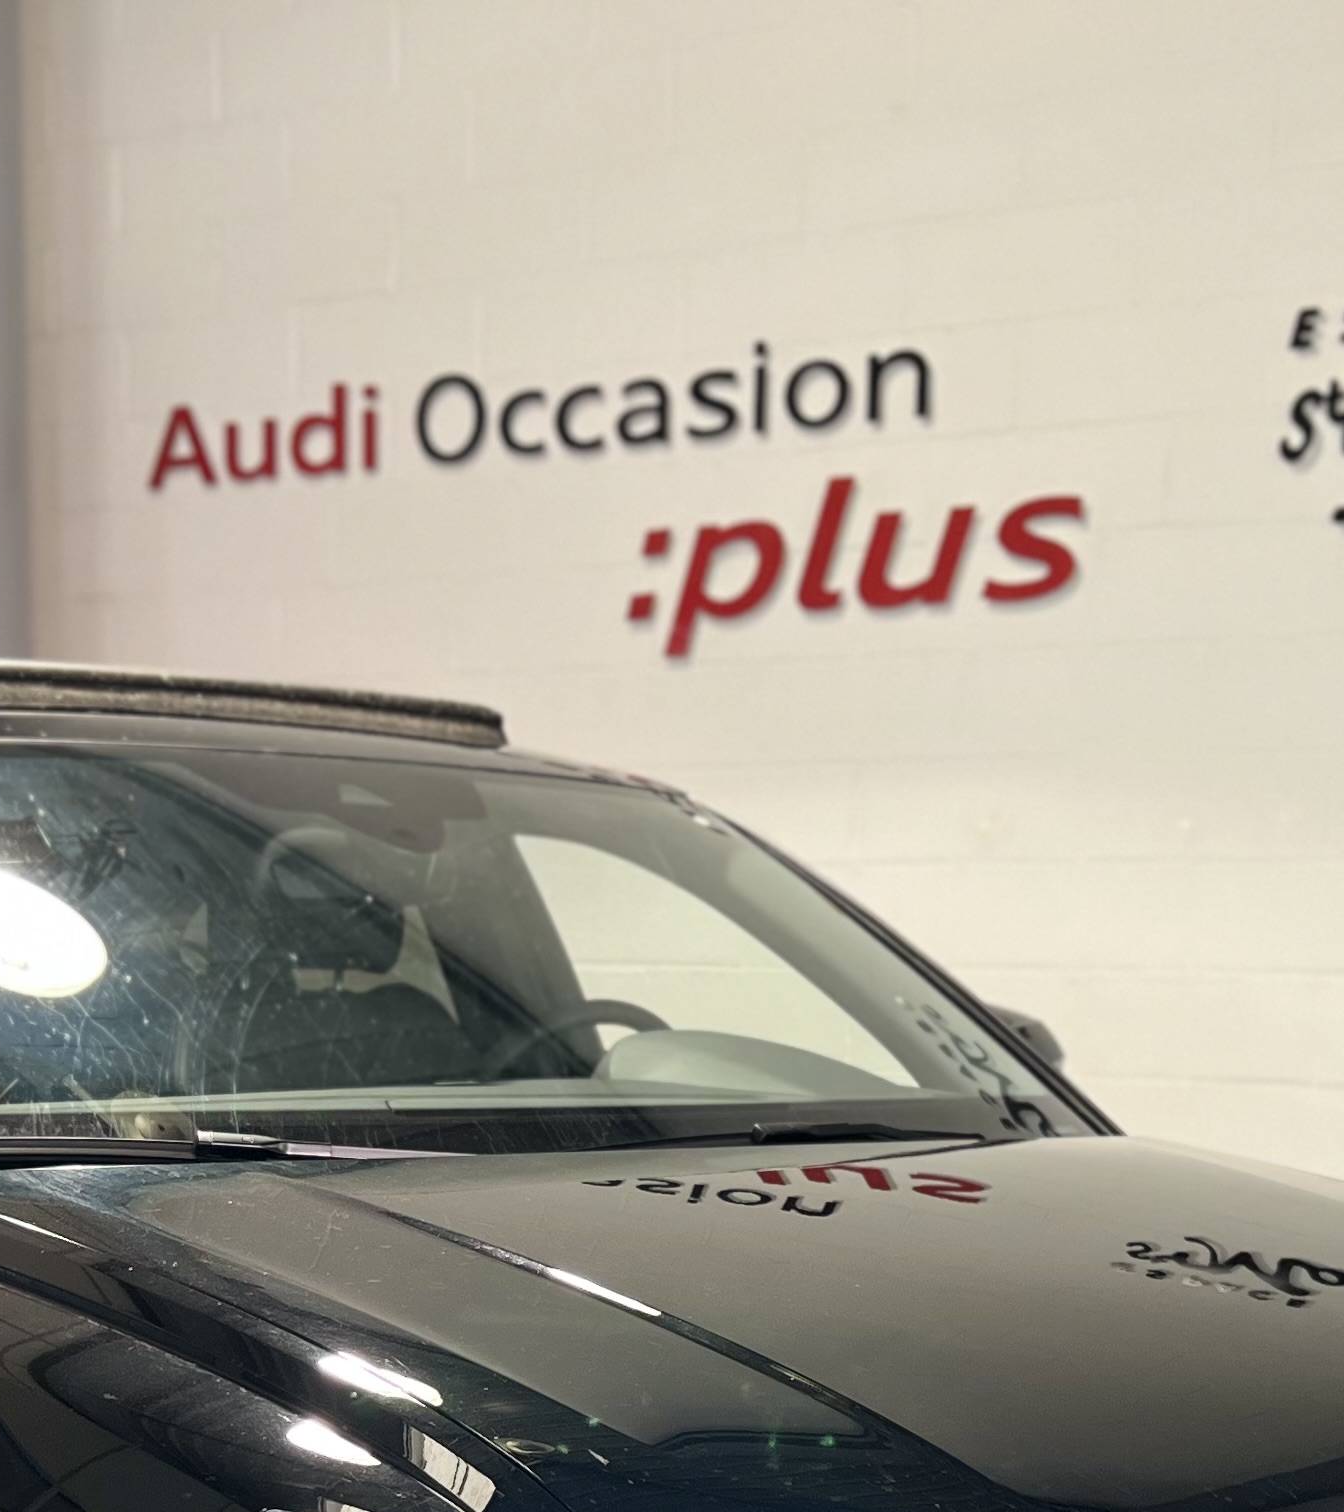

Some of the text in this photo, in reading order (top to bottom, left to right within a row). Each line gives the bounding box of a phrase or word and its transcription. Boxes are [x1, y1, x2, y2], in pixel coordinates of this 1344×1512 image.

[149, 342, 932, 490] Audi Occasion
[628, 476, 1084, 658] :plus
